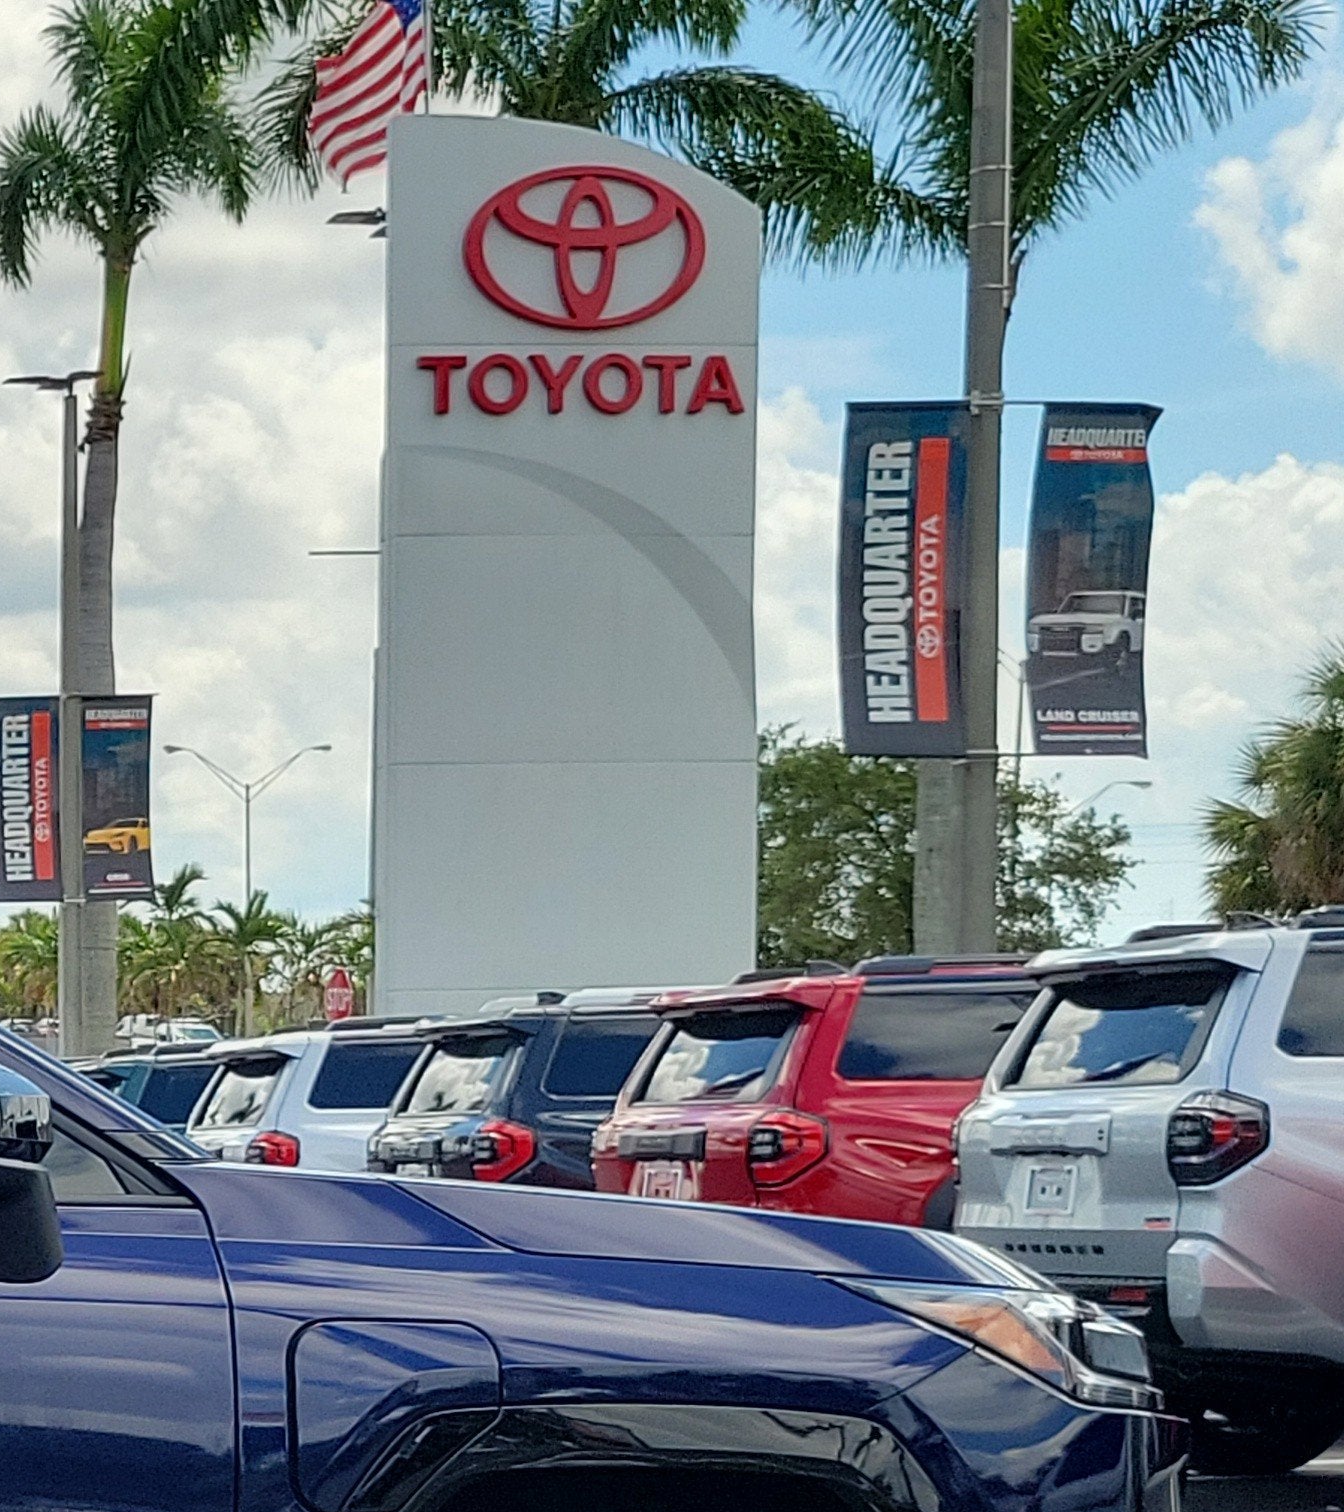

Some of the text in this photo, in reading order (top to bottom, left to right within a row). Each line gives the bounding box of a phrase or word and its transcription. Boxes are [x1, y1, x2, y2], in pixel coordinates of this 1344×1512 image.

[416, 352, 745, 416] TOYOTA
[1047, 428, 1146, 449] HEADQUARTE
[862, 439, 914, 723] HEADQUARTER
[918, 514, 941, 623] TOYOTA
[1036, 709, 1076, 722] LAND
[1, 714, 34, 882] HEADQUARTER
[34, 757, 50, 822] TOYOTA
